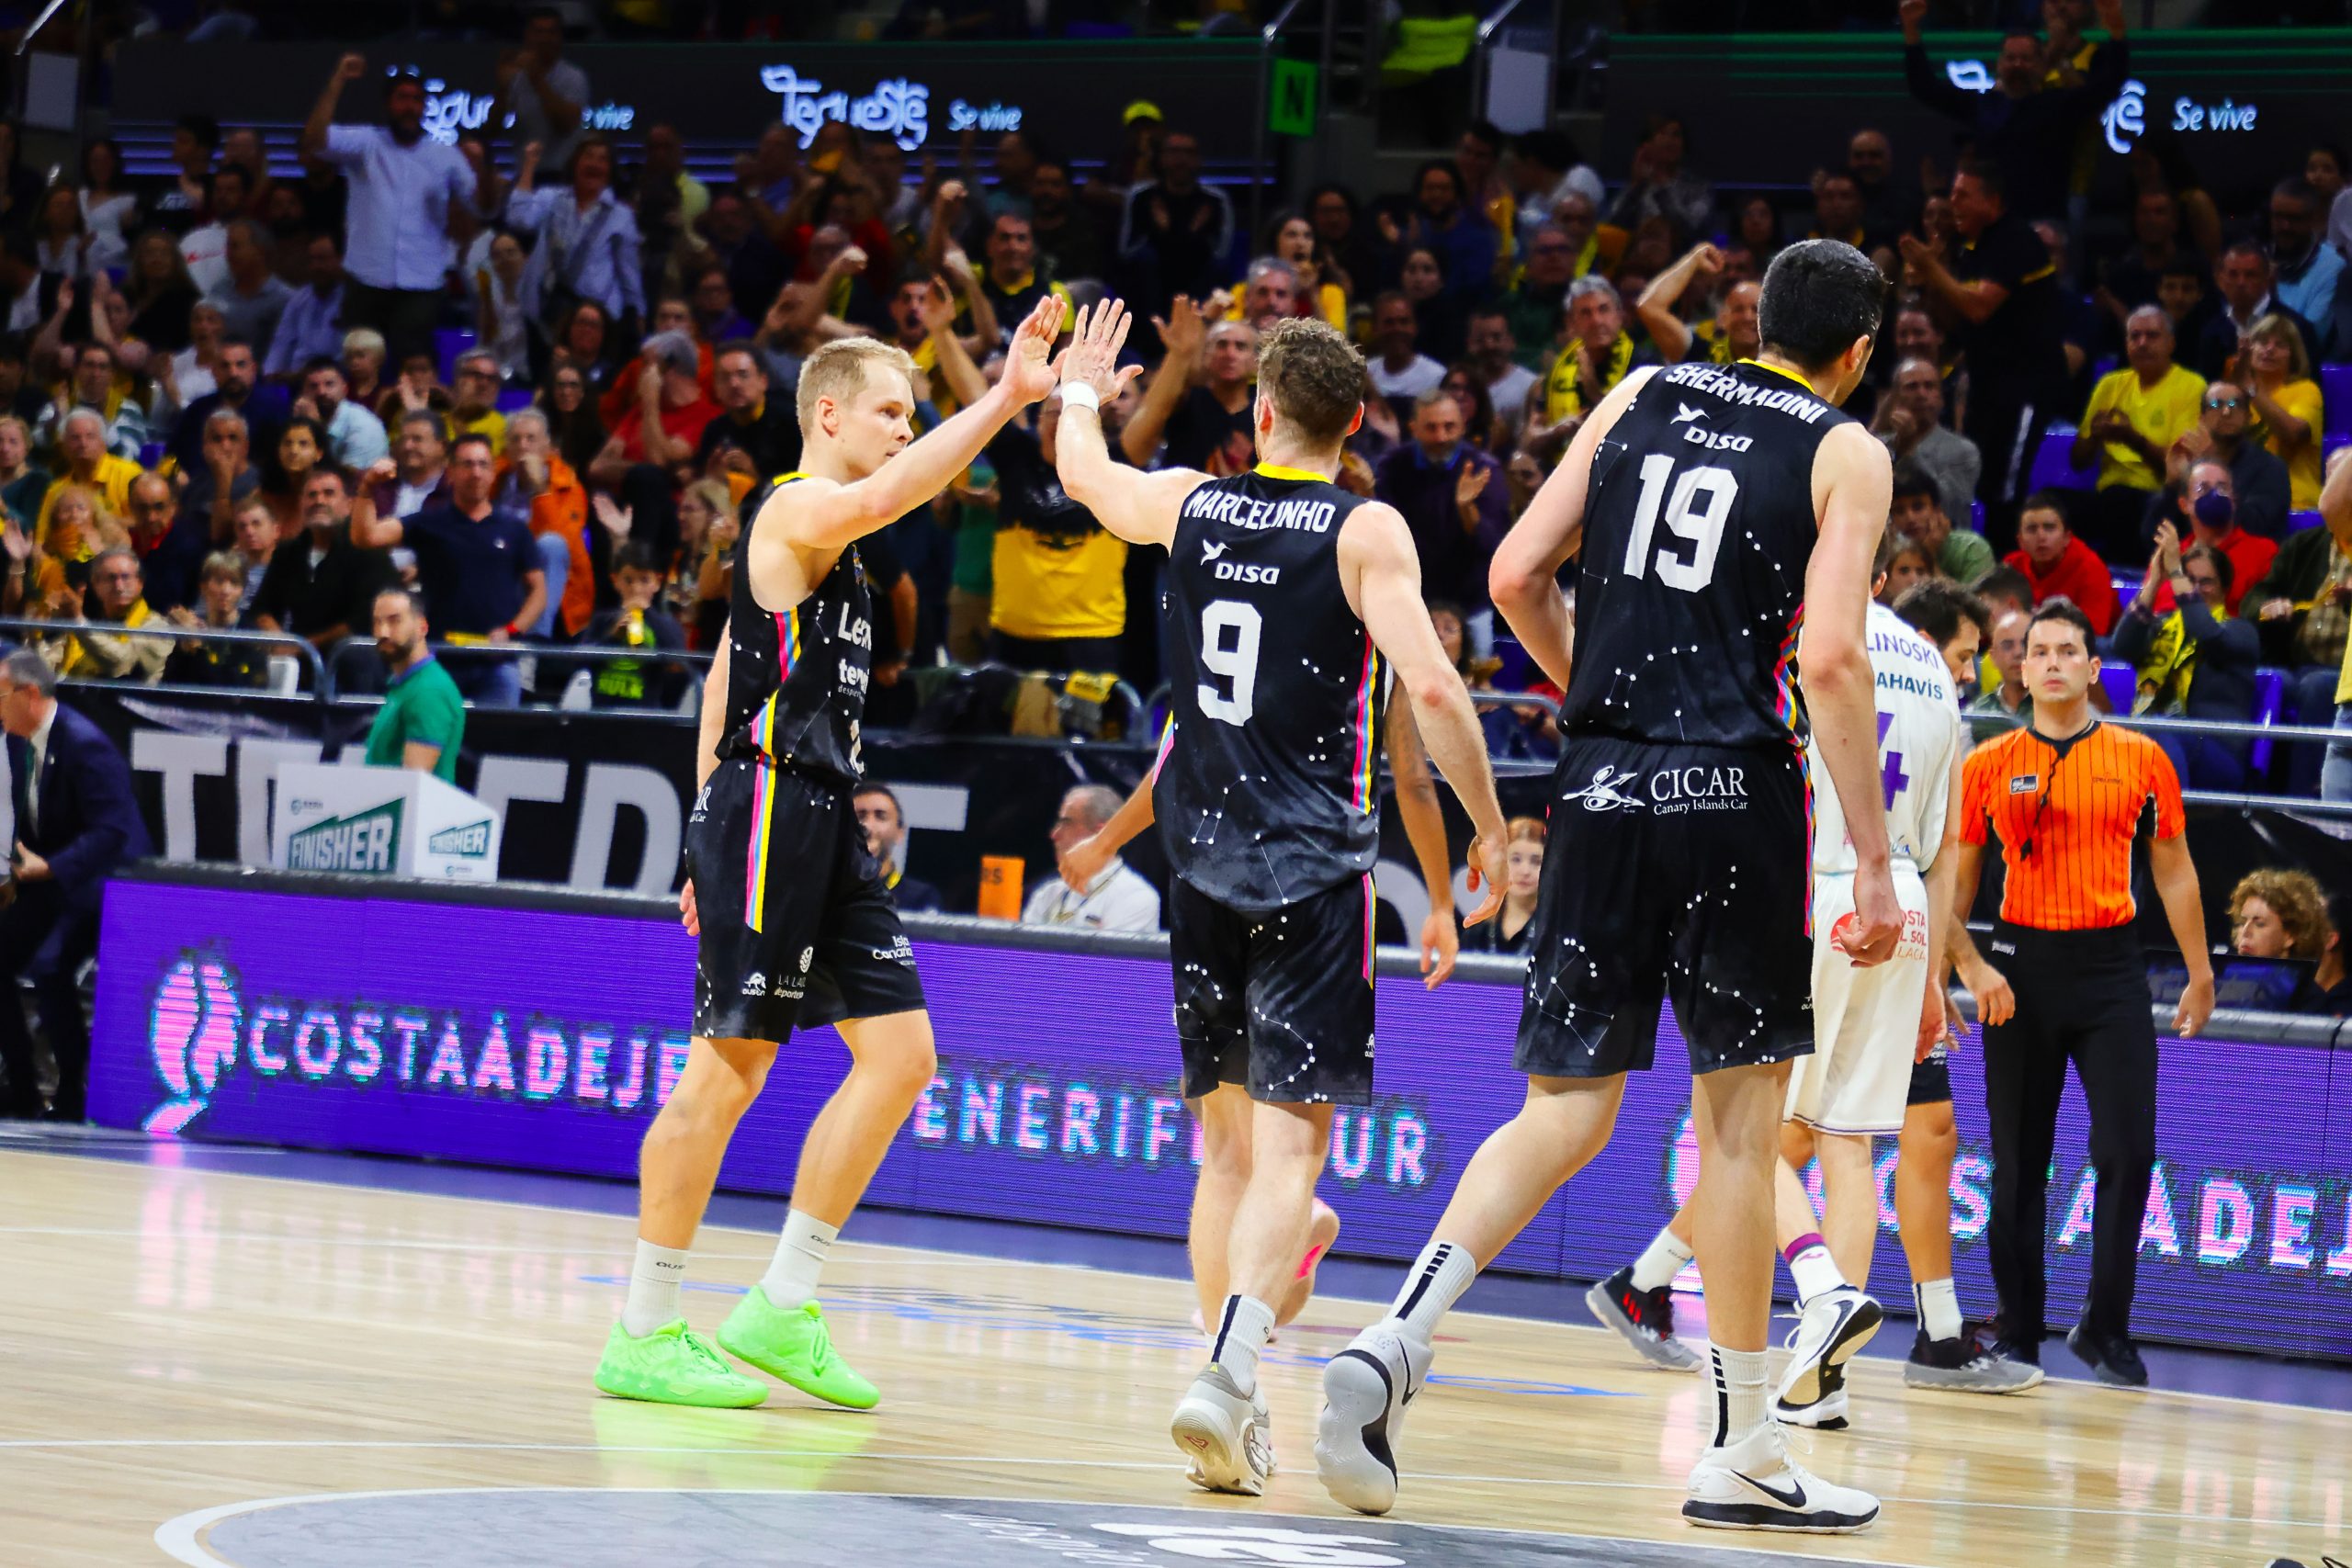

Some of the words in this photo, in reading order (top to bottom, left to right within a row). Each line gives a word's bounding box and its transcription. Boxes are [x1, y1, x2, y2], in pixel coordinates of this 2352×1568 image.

[948, 98, 978, 131] Se
[979, 102, 1022, 131] vive
[1283, 73, 1308, 122] N
[2172, 96, 2204, 131] Se
[2209, 98, 2256, 131] vive
[1666, 365, 1828, 424] SHERMADINI
[1183, 490, 1336, 533] MARCELINHO
[1623, 454, 1738, 592] 19
[1197, 600, 1262, 727] 9
[1876, 671, 1943, 701] AHAVÍS
[1650, 767, 1748, 801] CICAR
[1654, 802, 1690, 816] Canary
[1692, 799, 1729, 811] Islands
[1730, 797, 1748, 810] Car
[290, 816, 394, 870] FINISHER
[431, 827, 487, 853] FINISHER
[912, 1077, 1204, 1167] ENERIF
[1329, 1111, 1429, 1185] UR
